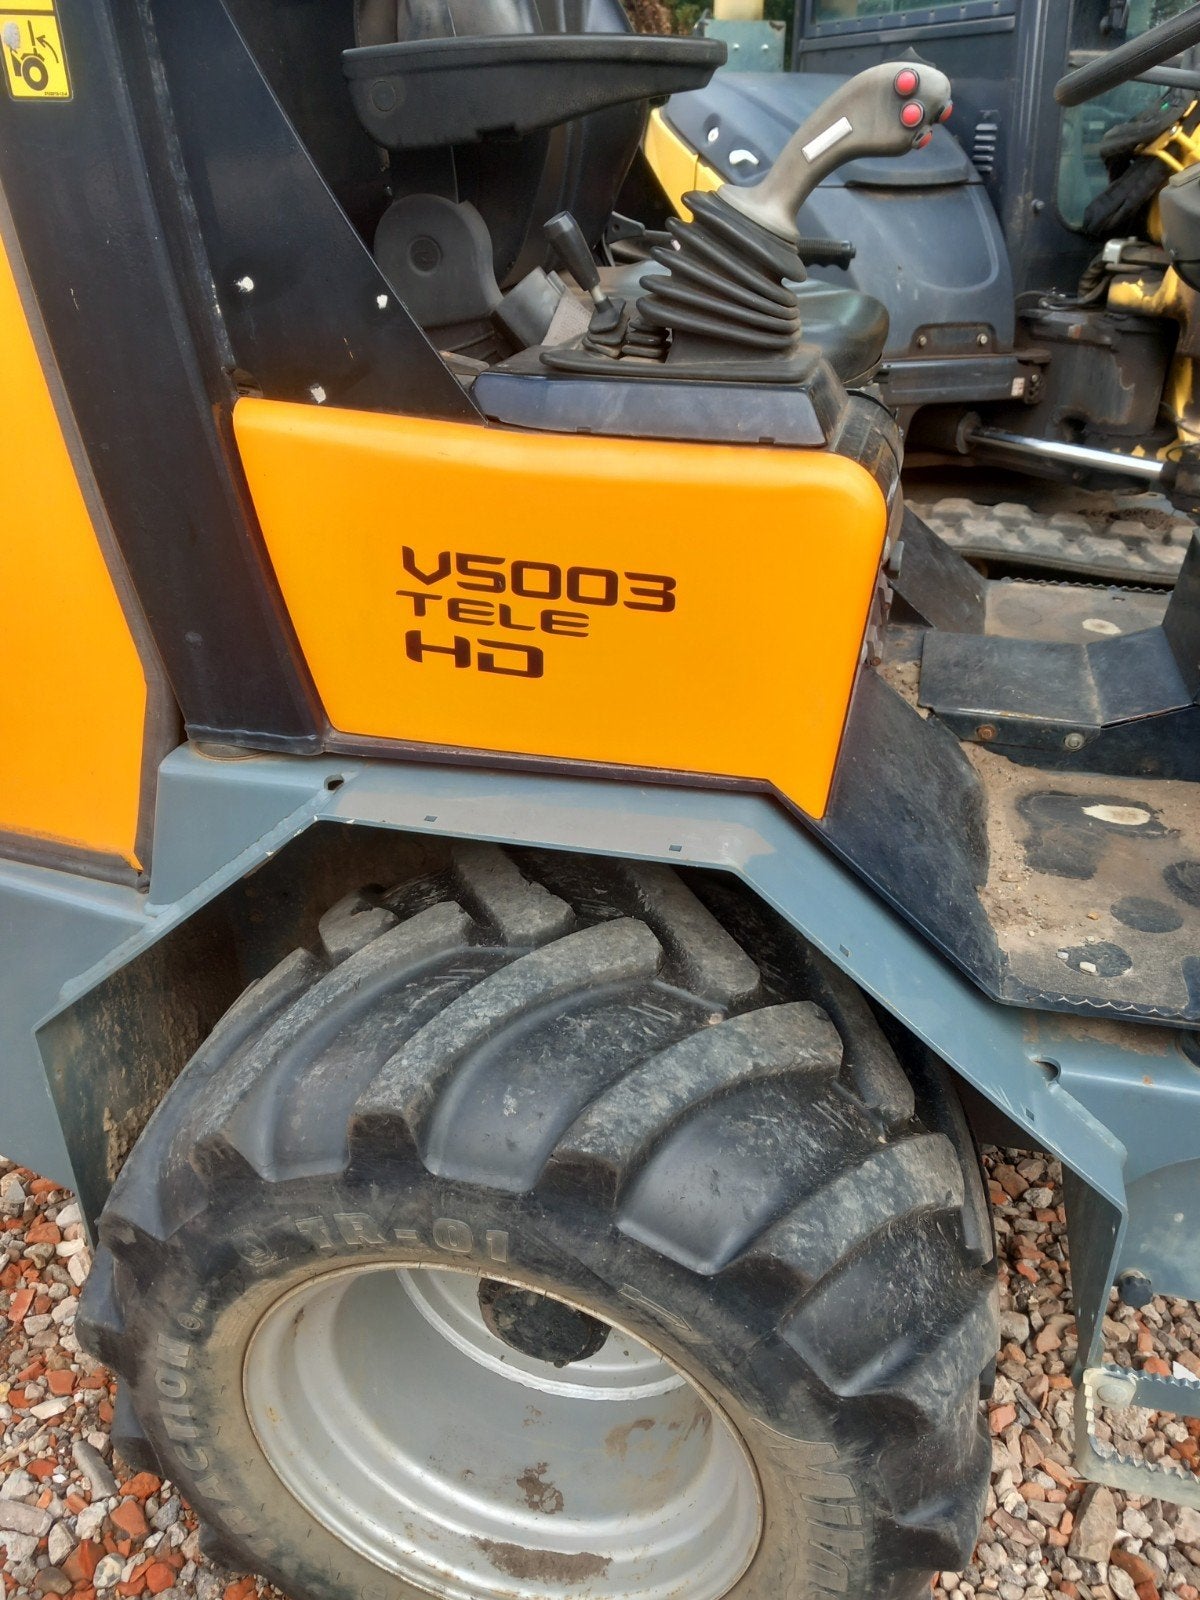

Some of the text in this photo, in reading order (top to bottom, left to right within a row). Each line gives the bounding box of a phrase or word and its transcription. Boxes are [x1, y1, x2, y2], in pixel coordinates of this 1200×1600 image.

[402, 545, 677, 613] V5003
[396, 590, 589, 637] TELE
[405, 629, 544, 679] HD
